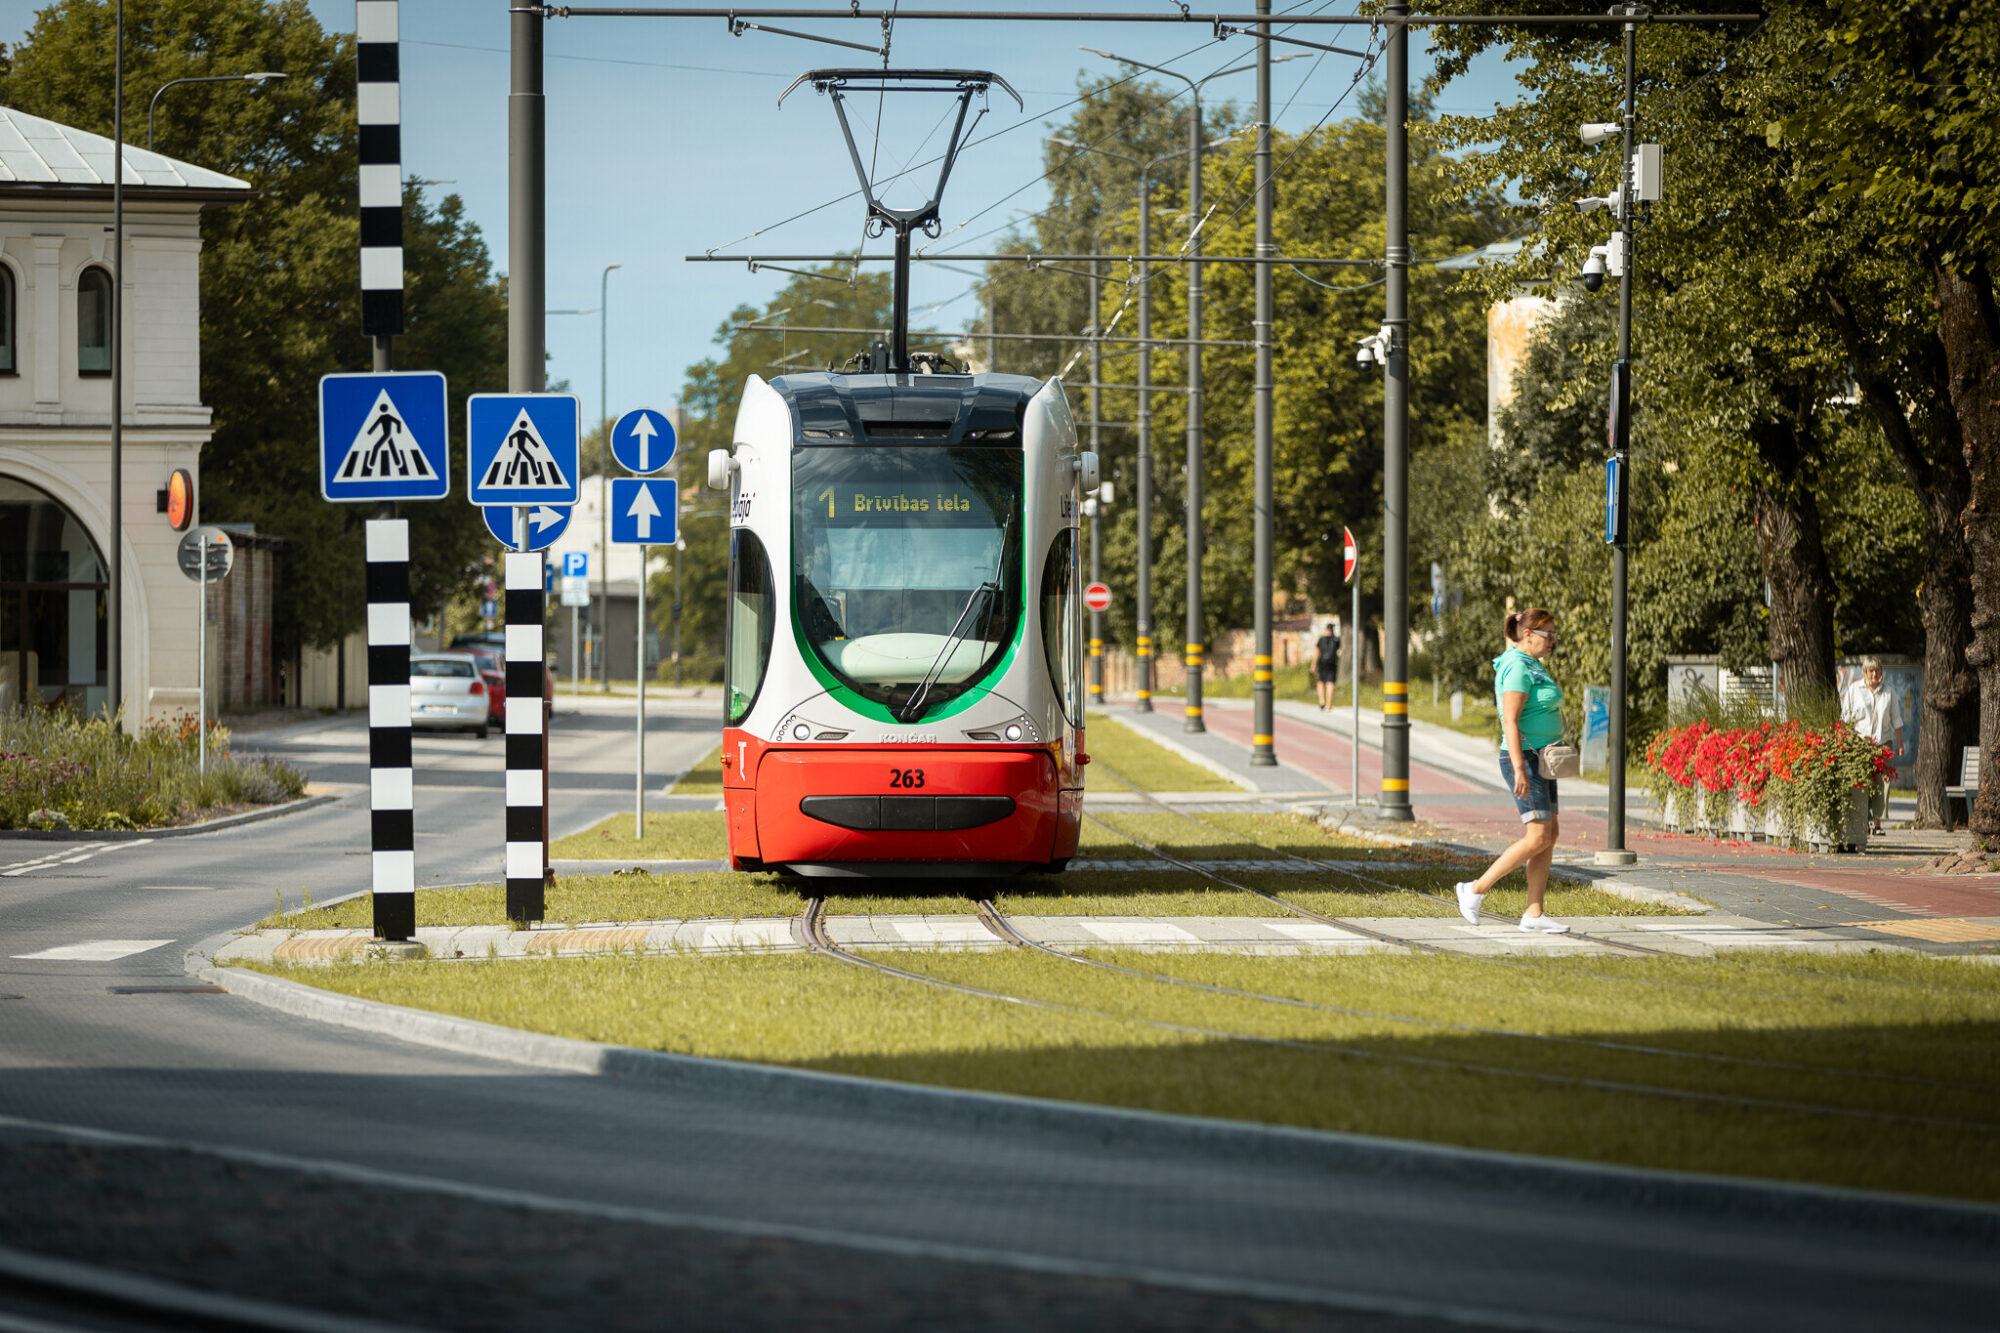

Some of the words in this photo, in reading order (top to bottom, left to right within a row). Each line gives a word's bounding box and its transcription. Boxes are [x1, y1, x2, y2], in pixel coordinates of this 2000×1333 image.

[818, 486, 835, 518] 1
[854, 494, 929, 512] Brīvības
[937, 494, 970, 512] iela
[568, 554, 585, 576] P
[890, 769, 925, 788] 263
